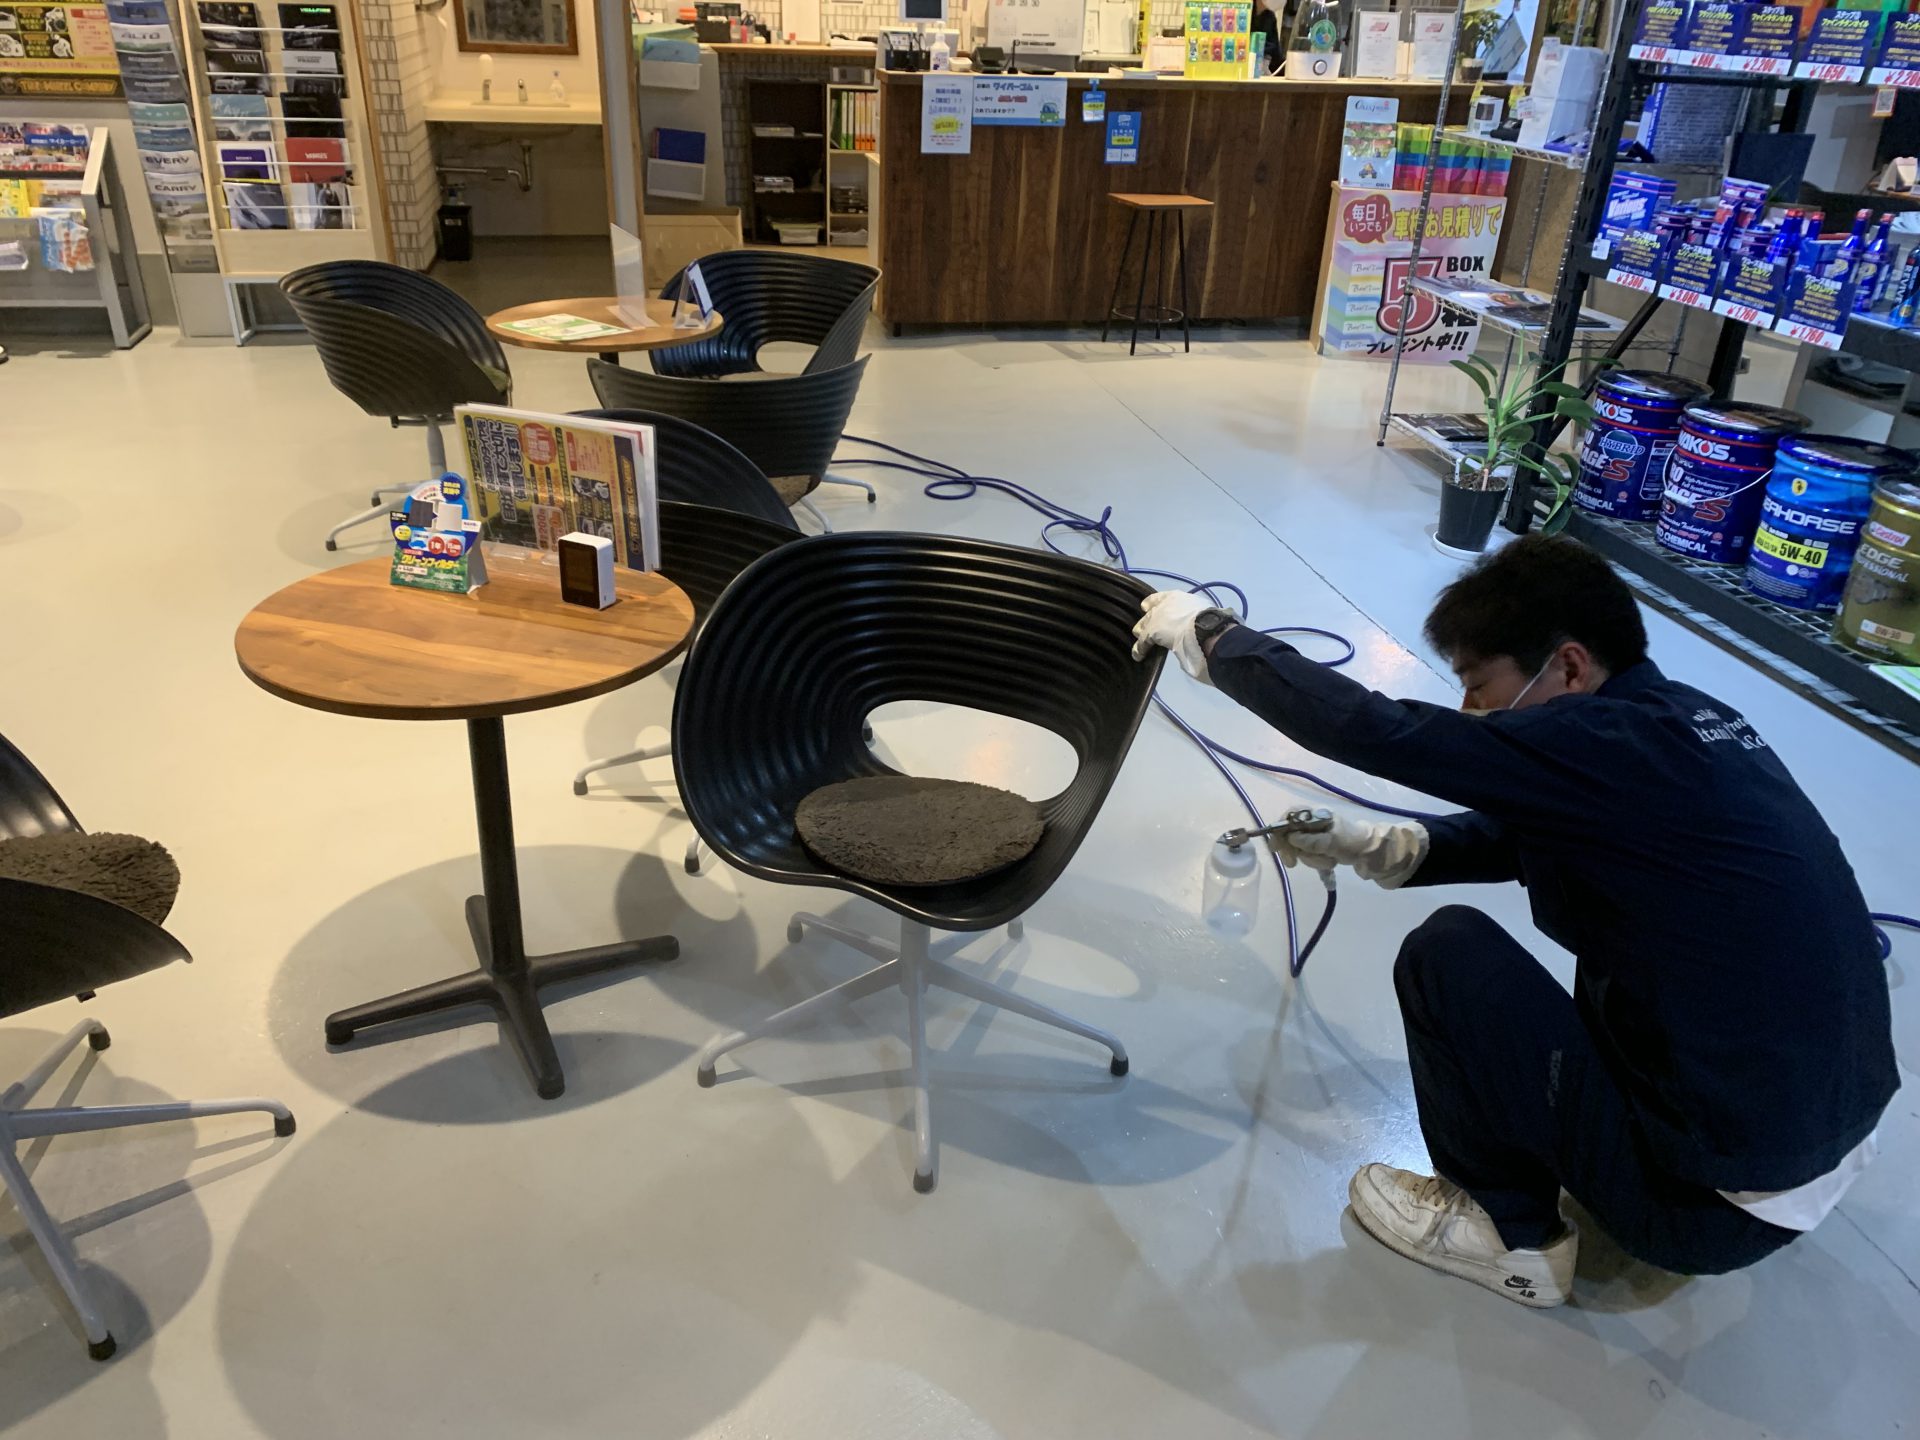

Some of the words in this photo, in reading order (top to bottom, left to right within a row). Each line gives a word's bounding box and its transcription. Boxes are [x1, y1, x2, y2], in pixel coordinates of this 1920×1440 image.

[232, 53, 258, 63] VOXY
[145, 156, 189, 164] EVERY
[155, 184, 196, 192] CARRY
[1446, 256, 1485, 272] BOX
[1376, 256, 1443, 336] 5
[1600, 437, 1645, 455] HYBRID
[1694, 498, 1732, 522] S
[1664, 531, 1708, 553] CHEMICAL
[1780, 542, 1822, 565] 5W-40
[1858, 544, 1905, 569] EDGE
[1510, 1274, 1533, 1287] NIKE
[1520, 1289, 1536, 1299] AIR
